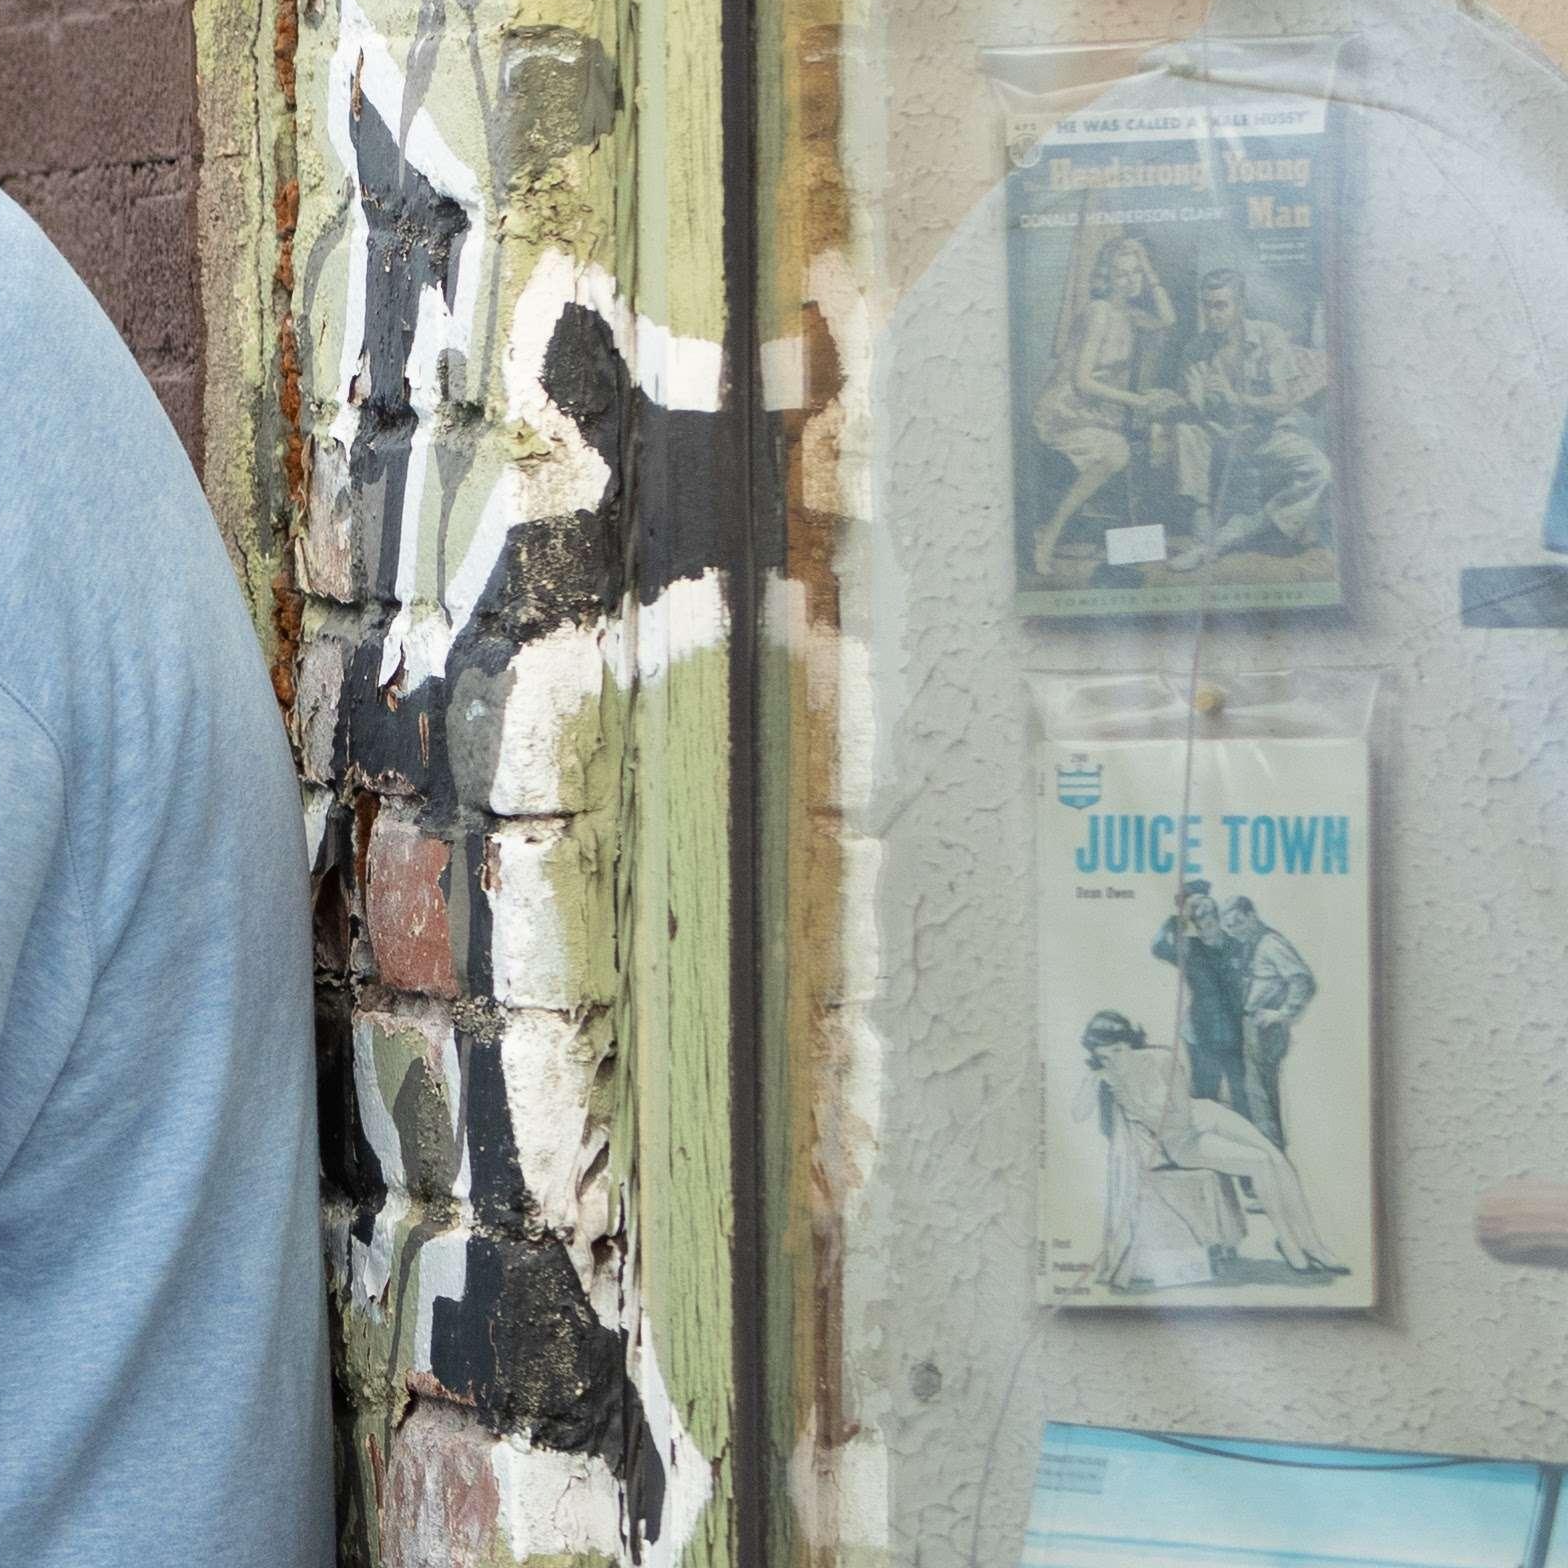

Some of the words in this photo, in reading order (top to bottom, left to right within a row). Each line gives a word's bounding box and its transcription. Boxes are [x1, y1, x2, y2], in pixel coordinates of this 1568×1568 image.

[1056, 120, 1077, 134] HE
[1084, 119, 1120, 133] WAS
[1126, 117, 1182, 131] CALLED
[1049, 156, 1208, 193] Headstrong
[1223, 154, 1312, 188] Young
[1247, 195, 1312, 229] Man
[1075, 814, 1203, 874] JUICE
[1220, 814, 1351, 875] TOWN
